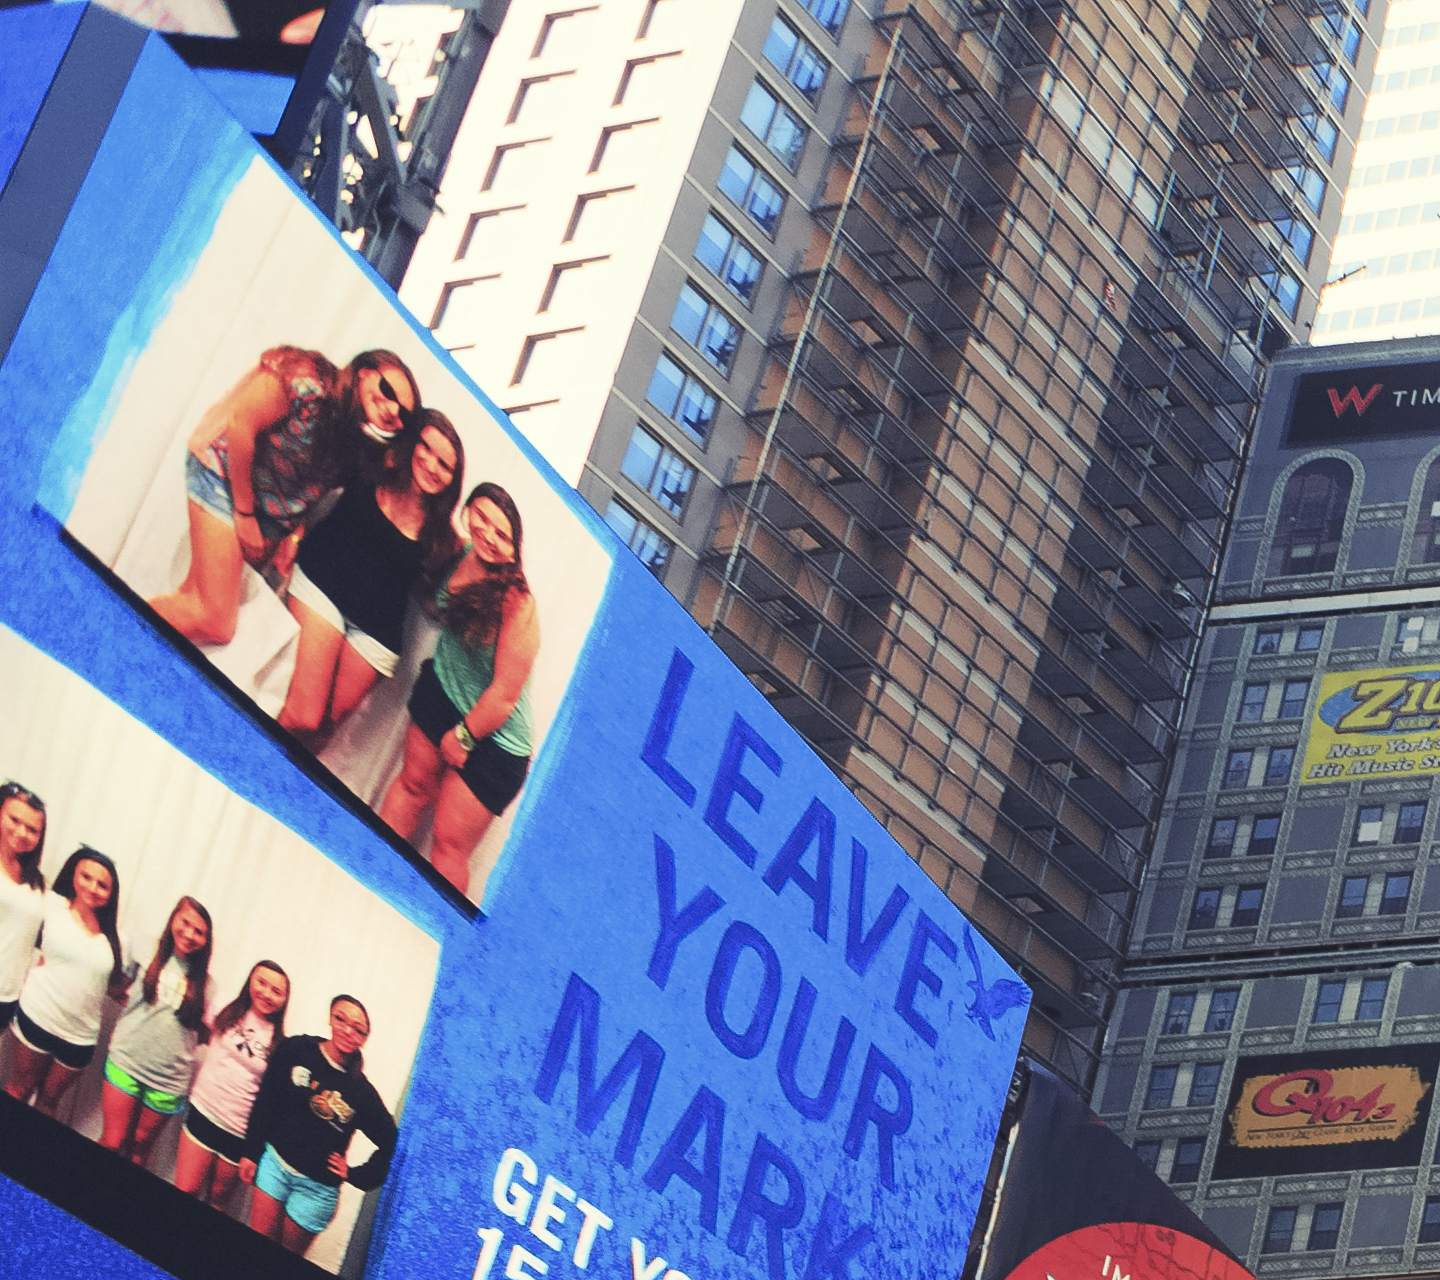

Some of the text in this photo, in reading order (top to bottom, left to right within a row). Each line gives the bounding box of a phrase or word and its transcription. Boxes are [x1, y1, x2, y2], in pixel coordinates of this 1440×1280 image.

[1328, 383, 1383, 418] W
[1307, 763, 1345, 779] Hit
[1350, 758, 1413, 775] Music
[1327, 743, 1380, 760] New
[640, 646, 958, 1050] LEAVE
[646, 835, 912, 1191] YOUR
[493, 1147, 612, 1269] GET
